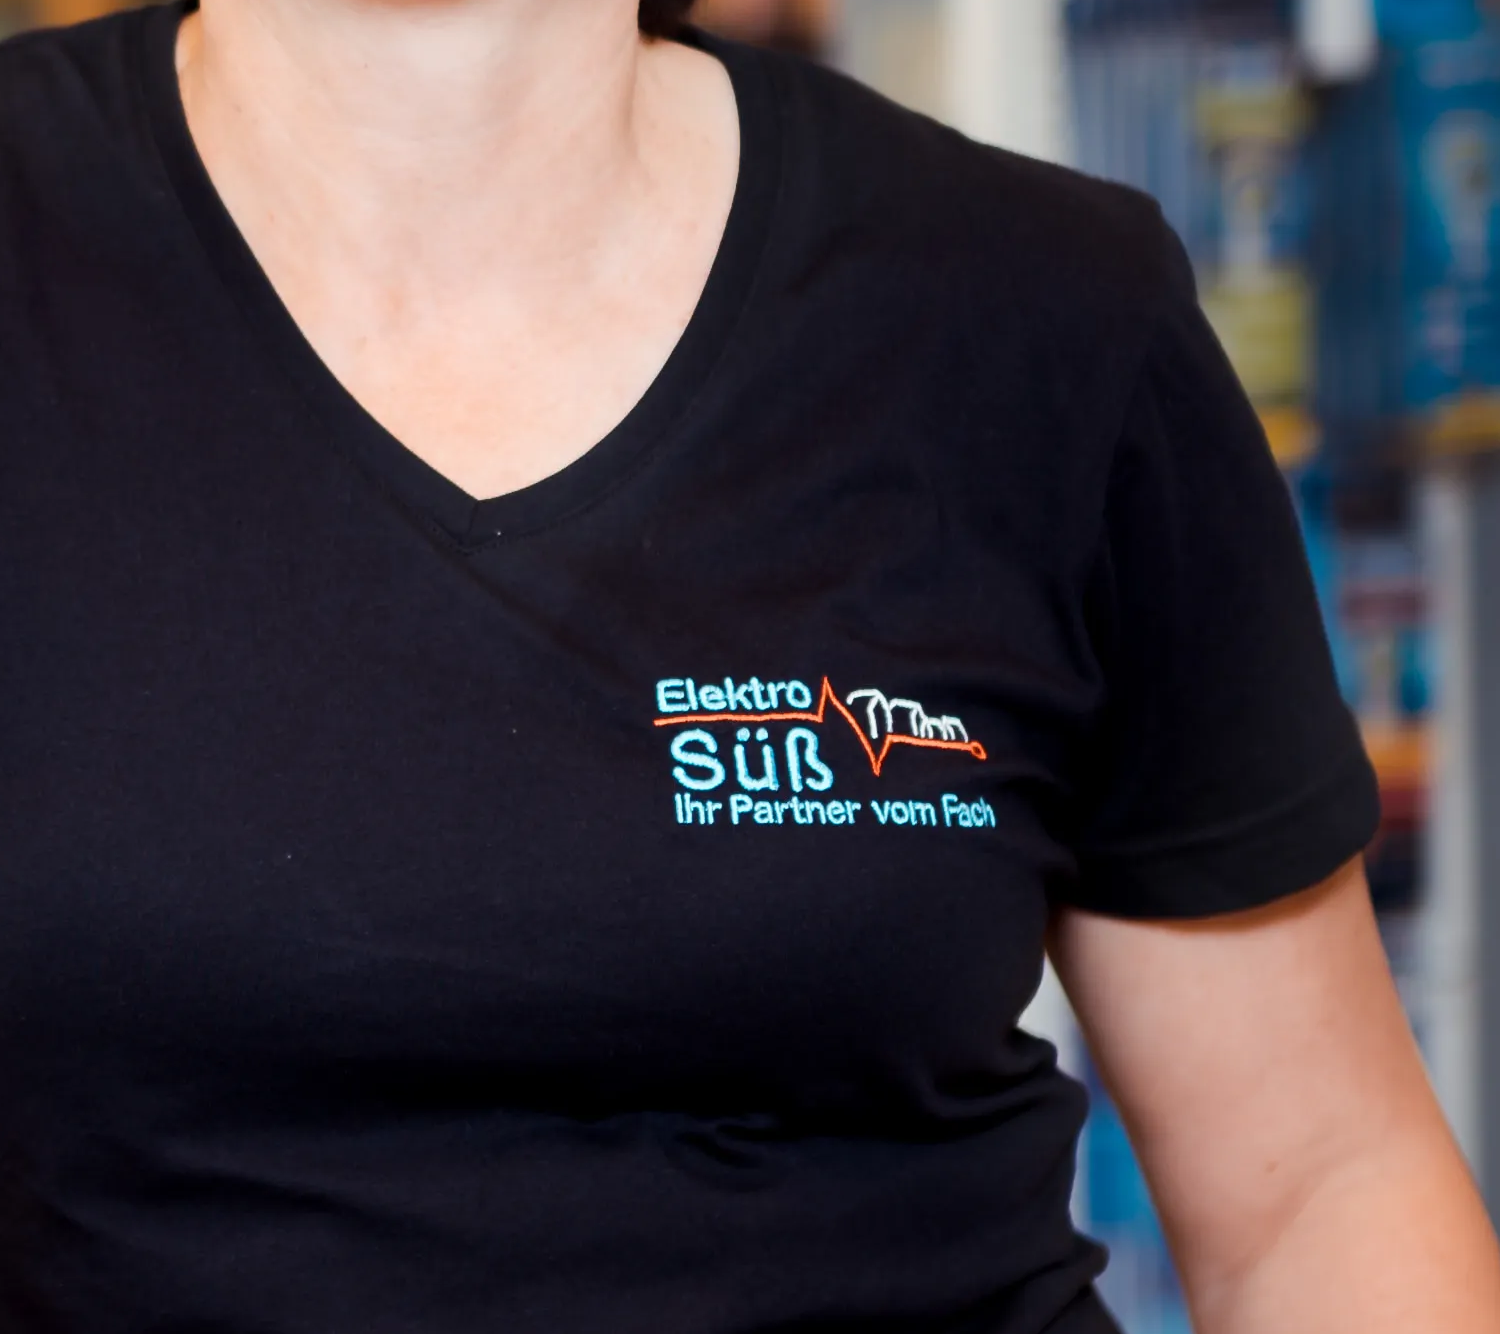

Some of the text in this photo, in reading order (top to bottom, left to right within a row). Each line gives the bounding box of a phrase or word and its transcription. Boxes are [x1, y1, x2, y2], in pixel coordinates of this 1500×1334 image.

[656, 676, 813, 713] Elektro
[670, 727, 834, 792] Süß
[674, 793, 996, 828] Ihr Partner vom Fach
